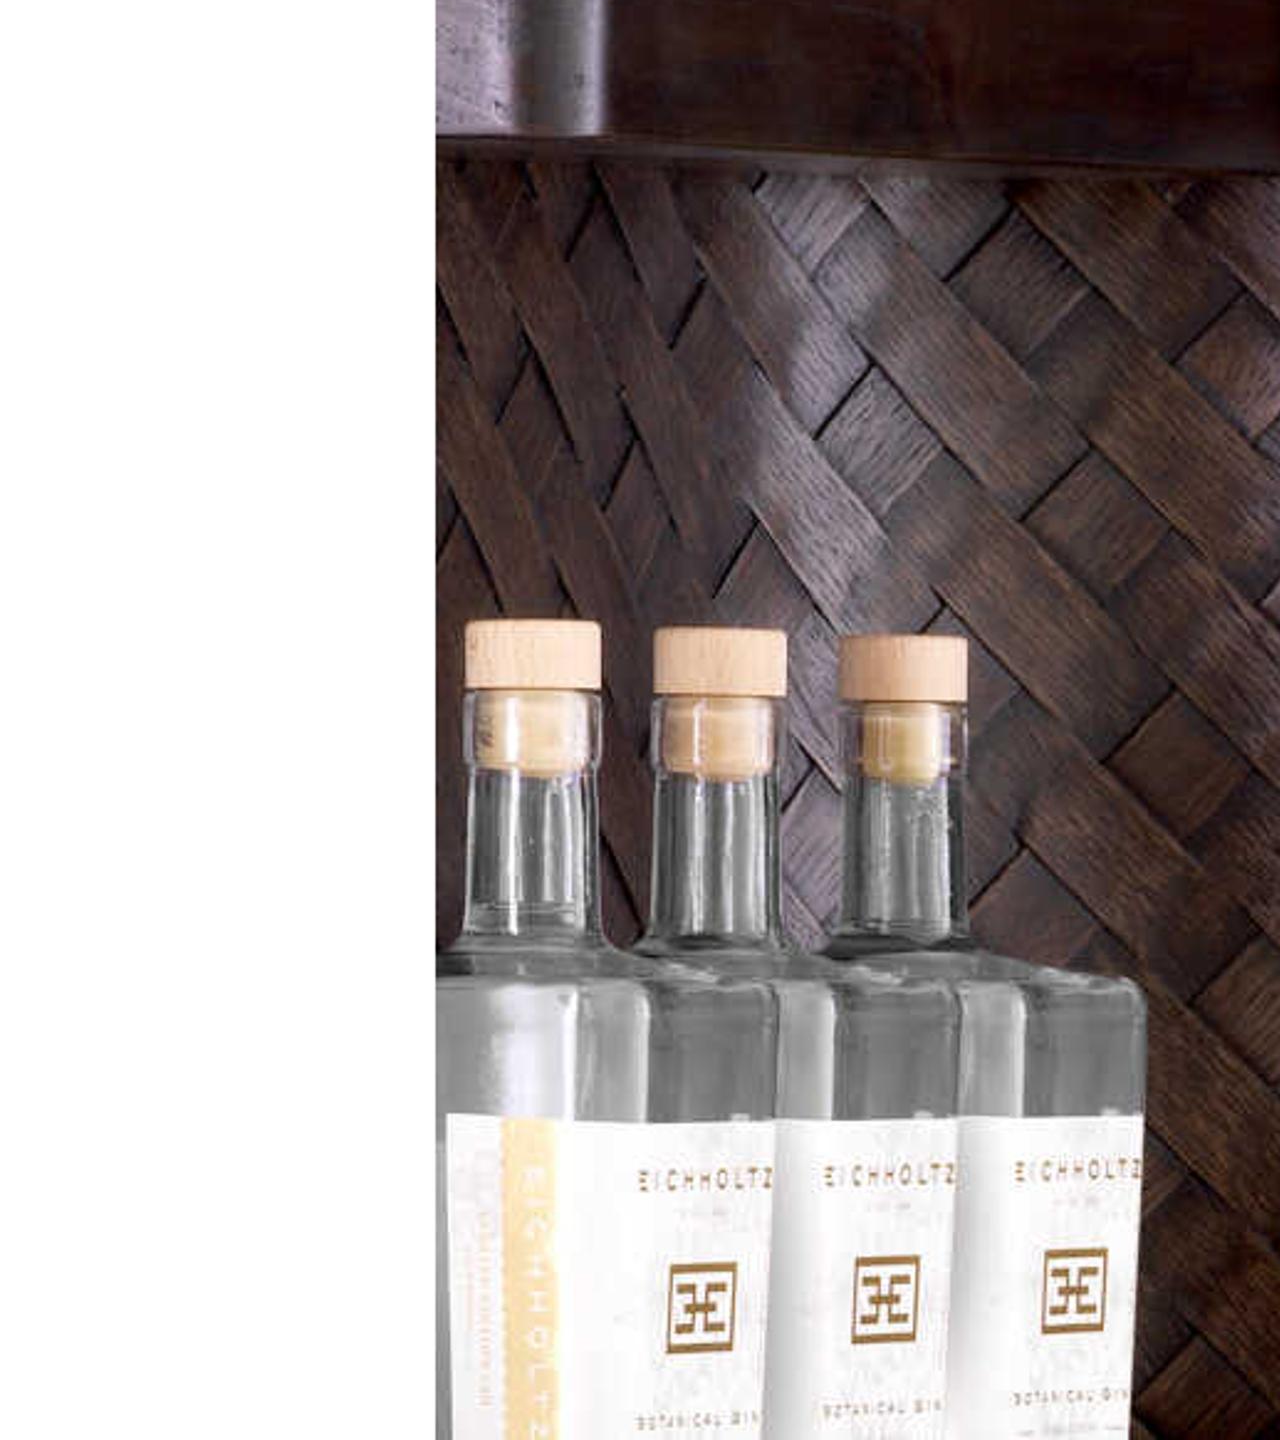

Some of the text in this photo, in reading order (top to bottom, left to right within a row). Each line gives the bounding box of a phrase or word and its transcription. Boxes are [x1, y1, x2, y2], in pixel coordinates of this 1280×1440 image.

[639, 1166, 773, 1192] EICHHOLTZ
[824, 1163, 954, 1187] EICHHOLTZ
[1014, 1158, 1142, 1181] EICHHOLTZ
